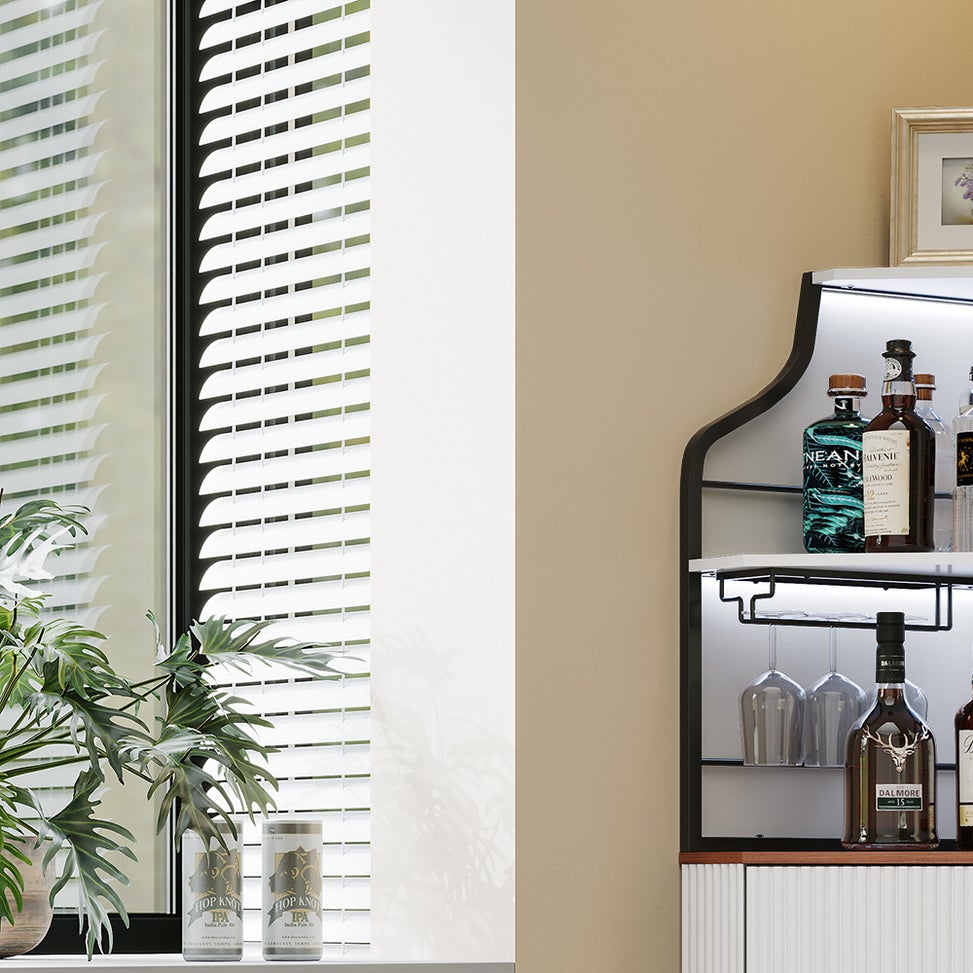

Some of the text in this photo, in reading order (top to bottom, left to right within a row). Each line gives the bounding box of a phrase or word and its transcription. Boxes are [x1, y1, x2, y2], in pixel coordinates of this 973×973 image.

[867, 490, 875, 500] 12
[896, 798, 905, 806] 15
[195, 896, 241, 912] HOP KNOT
[275, 896, 297, 912] HOP
[211, 911, 230, 923] IPA
[291, 911, 310, 923] IPA
